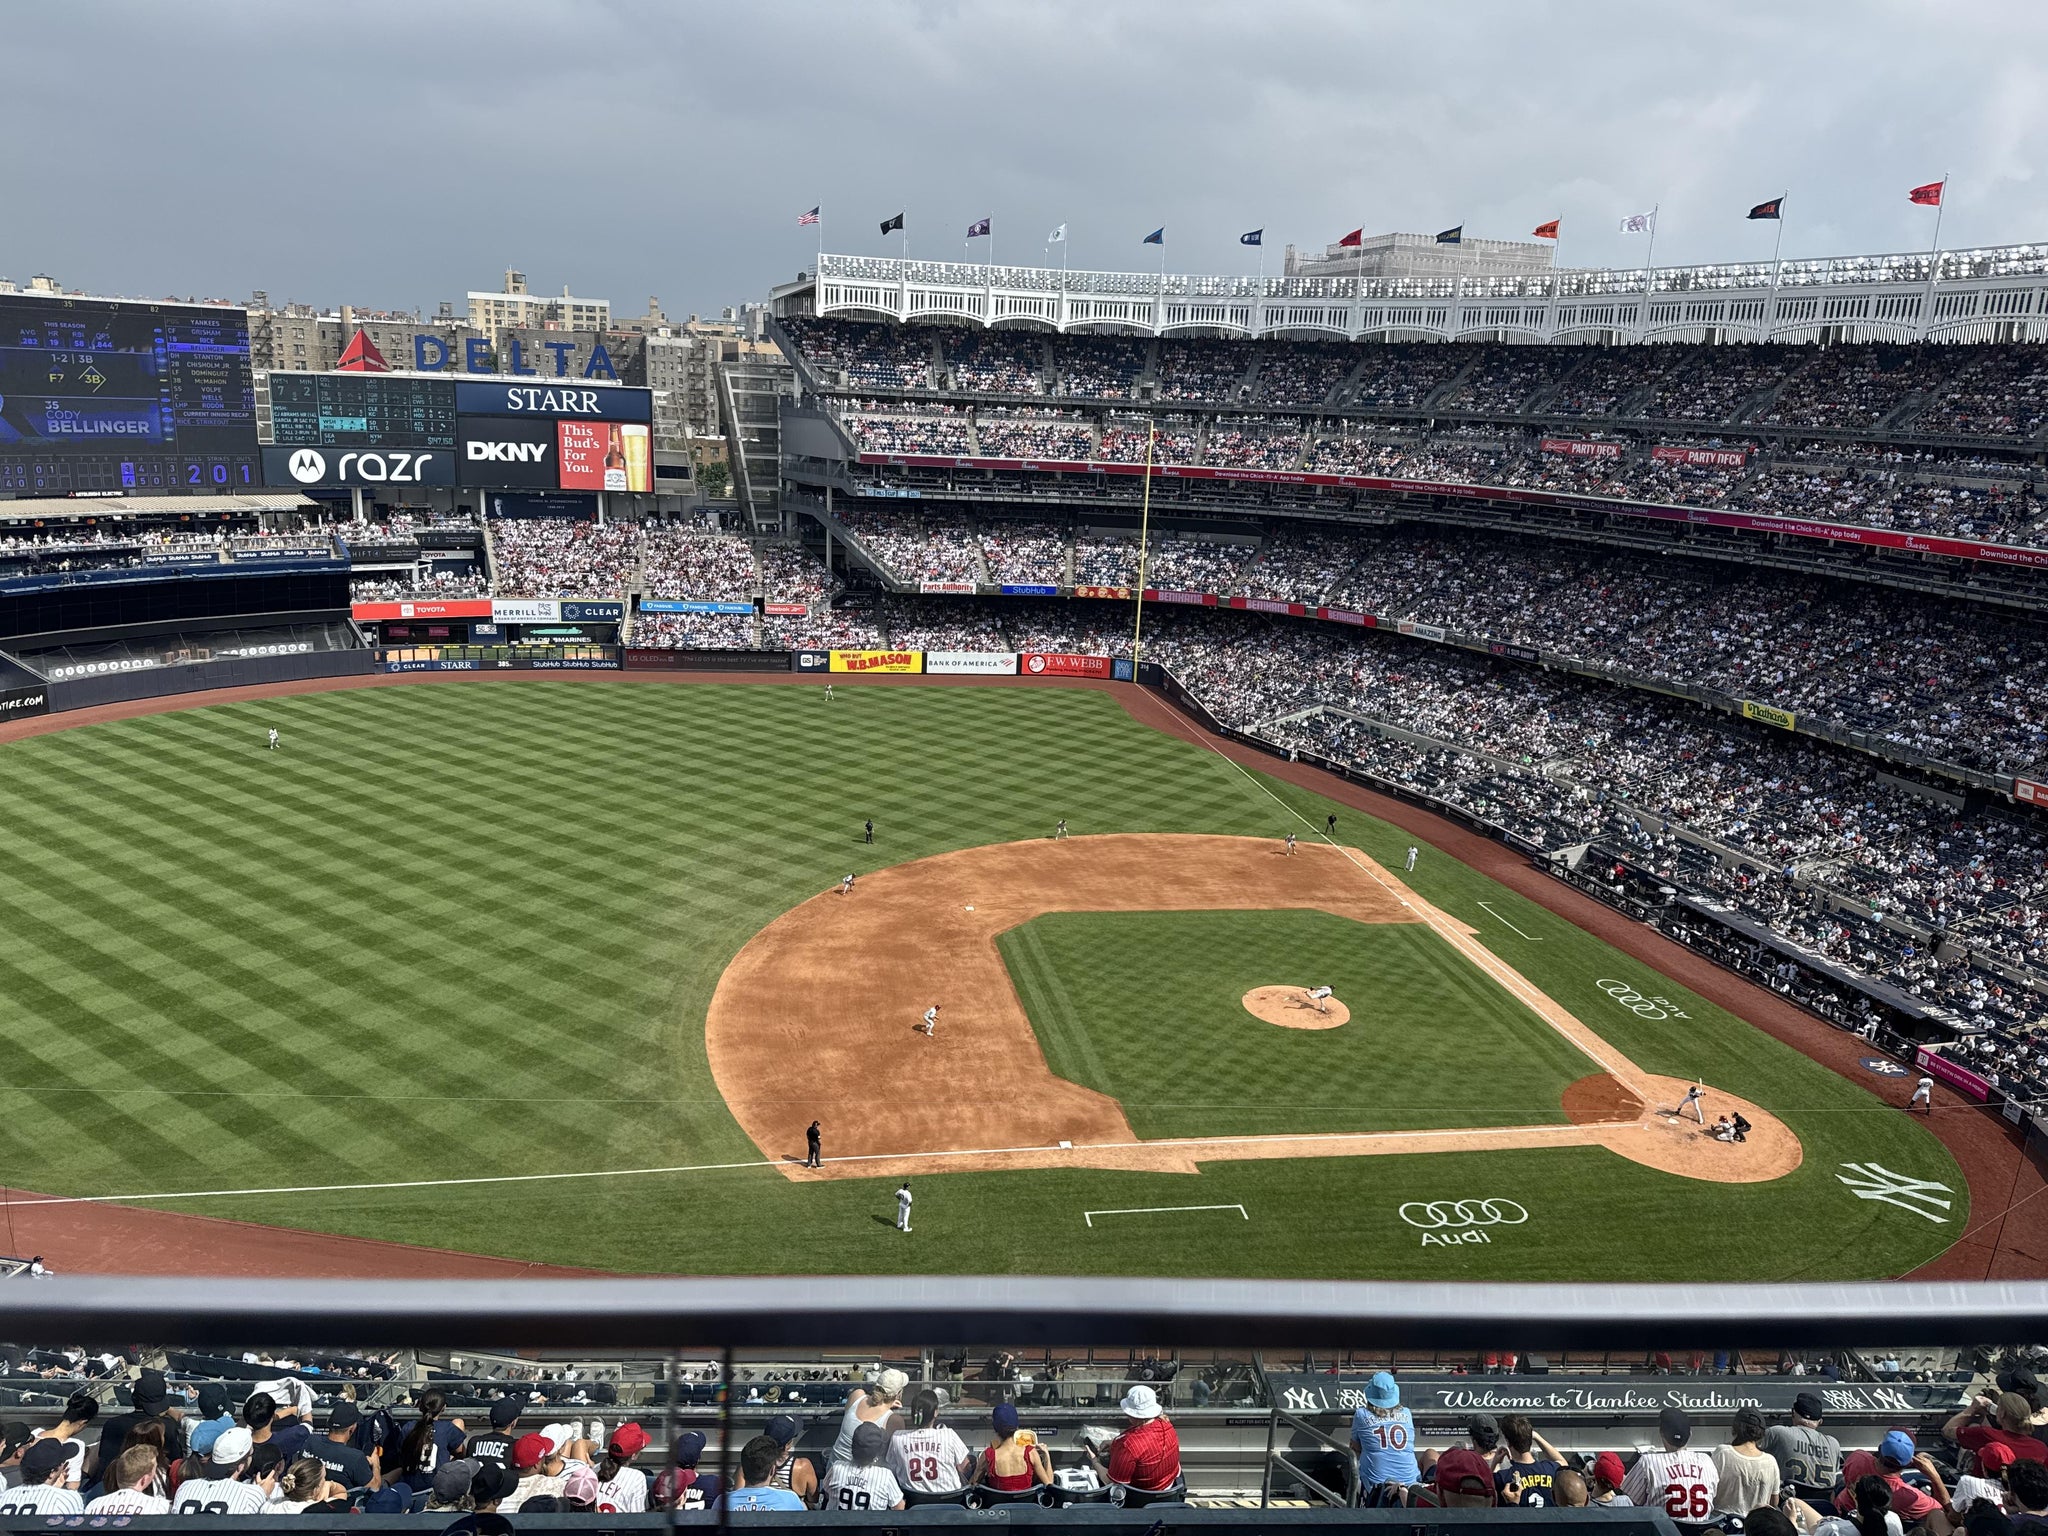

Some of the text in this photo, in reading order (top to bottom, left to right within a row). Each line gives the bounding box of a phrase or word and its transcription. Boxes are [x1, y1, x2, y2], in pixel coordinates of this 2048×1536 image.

[78, 355, 93, 364] 3B
[414, 334, 618, 380] DELTA
[49, 374, 64, 383] F7
[85, 375, 100, 384] 3B
[277, 386, 310, 396] 7 2
[45, 401, 59, 410] 35
[507, 387, 601, 414] STARR
[46, 410, 81, 420] CODY
[48, 420, 150, 434] BELLINGER
[562, 424, 593, 436] This
[563, 436, 599, 449] Bud's
[467, 441, 548, 462] DKNY
[564, 449, 586, 460] For
[1571, 444, 1595, 453] PARTY
[1597, 445, 1618, 456] DECK
[1688, 452, 1716, 463] PARTY
[188, 465, 250, 483] 2 0 1
[339, 453, 432, 481] razr
[564, 461, 593, 473] You.
[1752, 519, 1784, 528] Download
[1830, 529, 1843, 538] App
[1844, 531, 1861, 540] today
[1980, 548, 2032, 562] Download the
[1158, 591, 1203, 604] BENIHANA
[1246, 599, 1289, 614] BENIHANA
[1327, 609, 1364, 624] BENIHANA
[1415, 628, 1441, 640] AMAZING
[1047, 657, 1102, 668] F.W. WEBB
[1748, 703, 1789, 726] Nathan's
[1648, 996, 1693, 1019] Audi
[1421, 1228, 1492, 1247] Audi
[1437, 1389, 1762, 1410] Welcome to Yankee Stadium
[1822, 1390, 1855, 1399] NEW
[1823, 1397, 1867, 1409] YORK
[1373, 1424, 1407, 1450] 10
[473, 1441, 508, 1458] JUDGE
[904, 1442, 941, 1454] SANTORE
[1793, 1440, 1829, 1459] JUDGE
[909, 1457, 938, 1482] 23
[1666, 1464, 1703, 1479] UTLEY
[846, 1476, 868, 1490] JUDGE
[1521, 1474, 1552, 1490] ARPER
[838, 1488, 870, 1510] 99
[1664, 1484, 1708, 1518] 26
